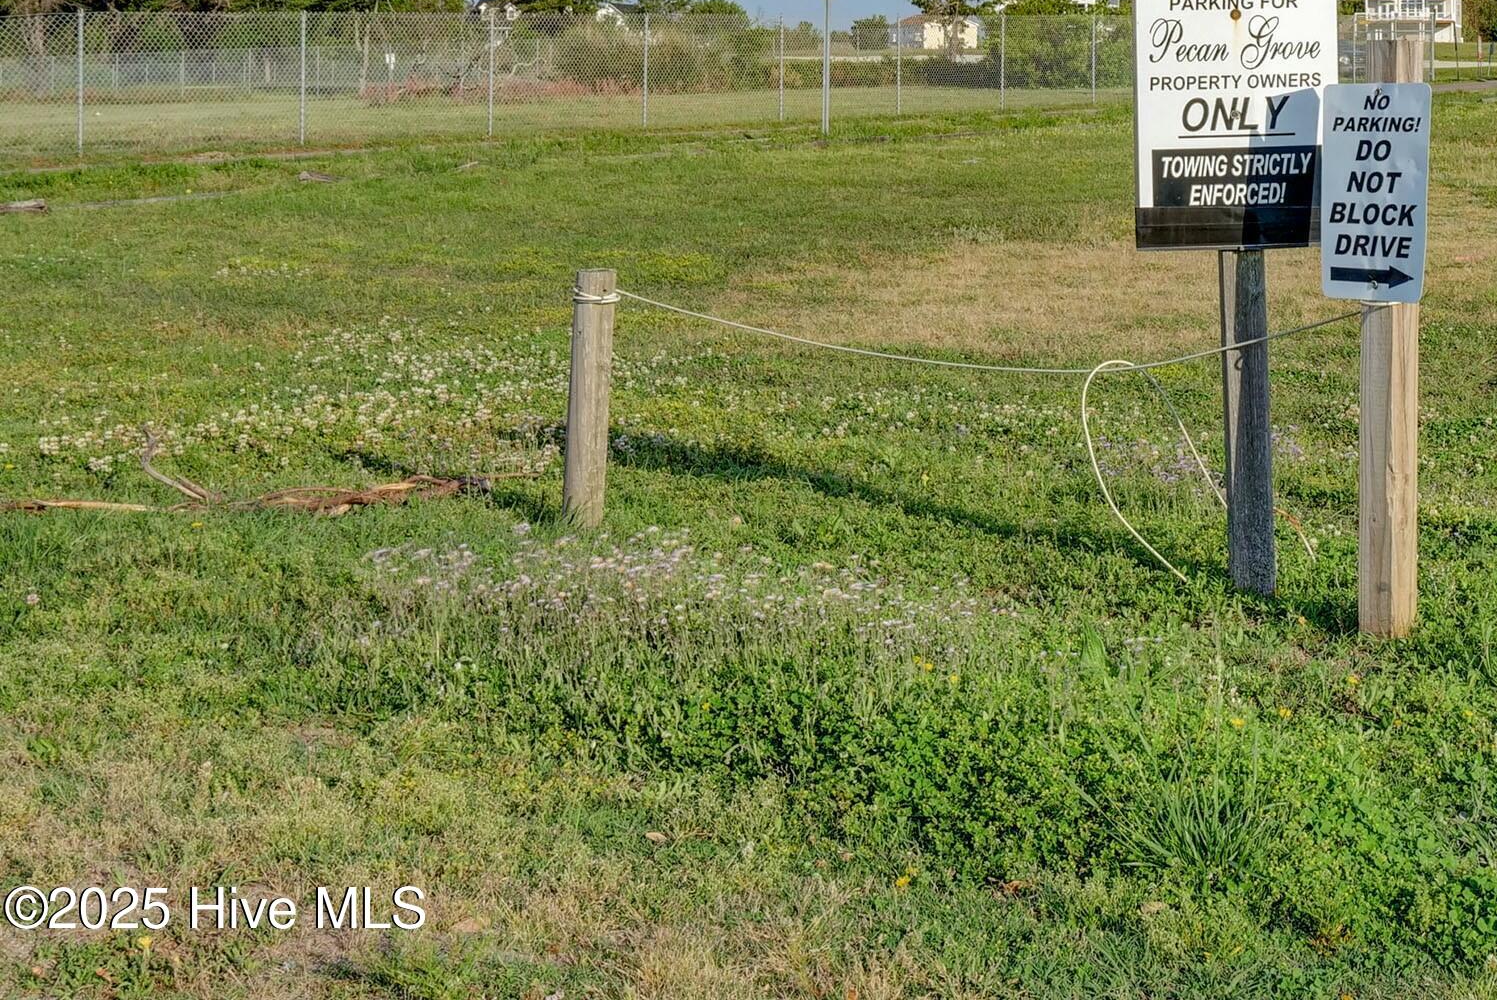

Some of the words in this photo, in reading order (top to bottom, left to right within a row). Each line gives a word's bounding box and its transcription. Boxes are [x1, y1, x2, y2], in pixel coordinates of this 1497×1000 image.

[1149, 18, 1229, 63] Pecan
[1240, 14, 1320, 70] Grove
[1150, 75, 1242, 90] PROPERTY
[1247, 72, 1321, 88] OWNERS
[1182, 96, 1290, 131] ONLY
[1364, 95, 1390, 110] NO
[1332, 117, 1421, 132] PARKING!
[1355, 140, 1391, 161] DO
[1161, 155, 1228, 178] TOWING
[1231, 153, 1312, 175] STRICTLY
[1189, 183, 1286, 206] ENFORCED!
[1346, 172, 1401, 194] NOT
[1329, 202, 1417, 227] BLOCK
[1334, 234, 1412, 259] DRIVE
